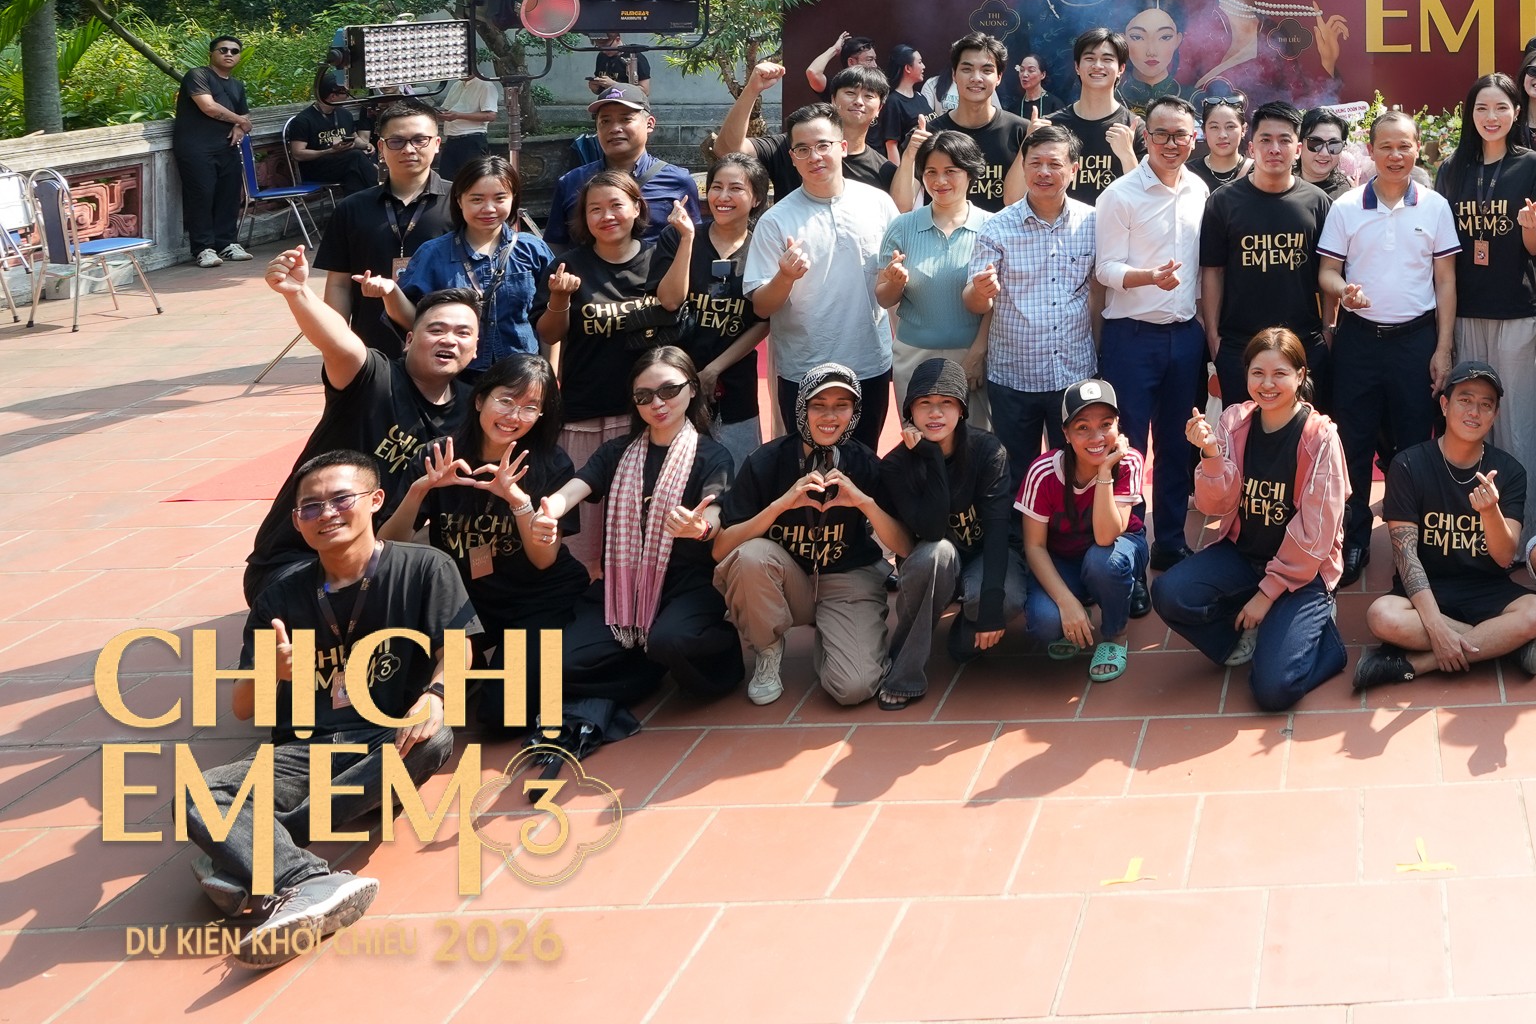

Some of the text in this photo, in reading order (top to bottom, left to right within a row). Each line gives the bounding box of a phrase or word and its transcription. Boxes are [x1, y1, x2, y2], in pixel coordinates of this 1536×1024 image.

[1499, 220, 1507, 231] 3
[1242, 250, 1267, 273] EM
[1269, 249, 1294, 271] EM
[583, 317, 612, 338] EM
[700, 311, 730, 337] EM
[1274, 507, 1284, 521] 3
[1456, 514, 1485, 532] CH
[502, 540, 513, 552] 3
[1423, 528, 1450, 556] EM
[1452, 532, 1477, 557] EM
[833, 546, 843, 560] 3
[380, 658, 392, 676] 3
